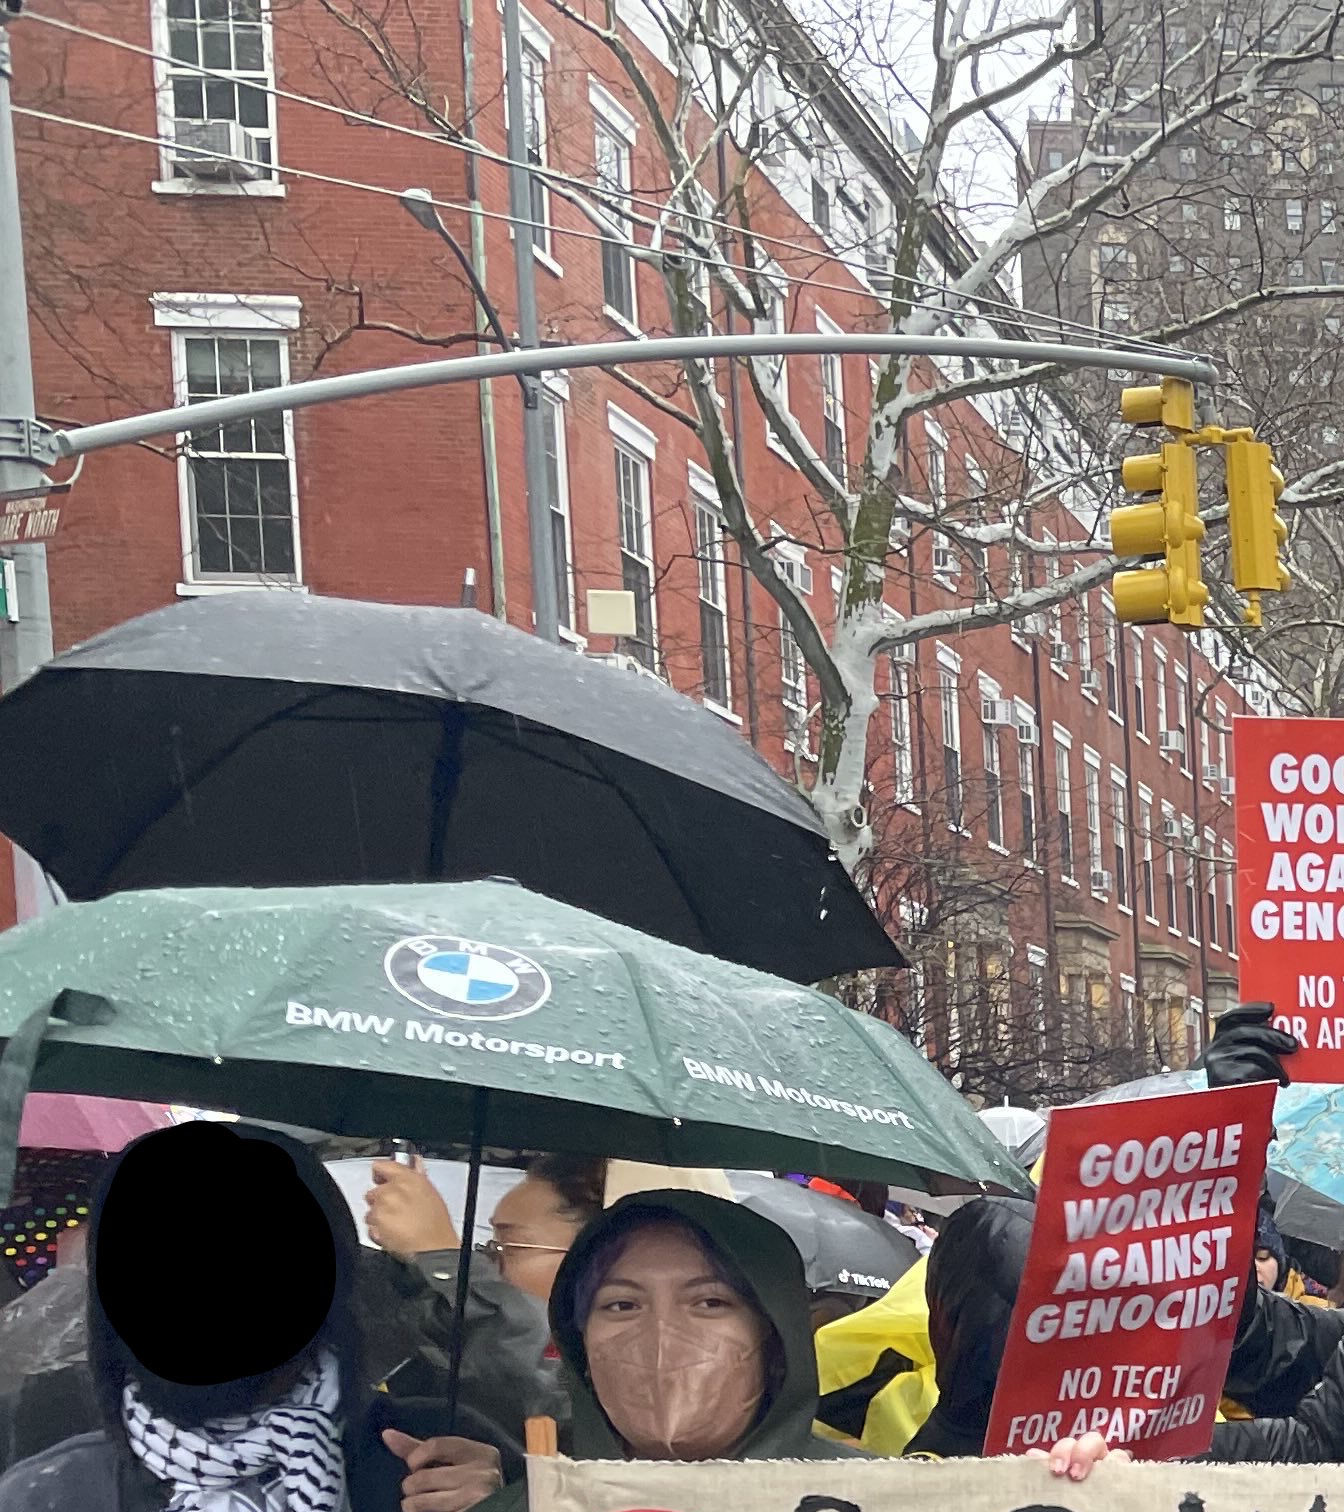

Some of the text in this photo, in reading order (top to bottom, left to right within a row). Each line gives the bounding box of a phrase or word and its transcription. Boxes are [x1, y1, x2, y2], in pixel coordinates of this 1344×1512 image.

[1299, 975, 1336, 1009] NO
[285, 1001, 626, 1070] BMW Motorsport
[1270, 1016, 1309, 1049] OR
[682, 1056, 915, 1130] BMW Motorsport
[1079, 1123, 1243, 1188] GOOGLE
[1063, 1176, 1238, 1242] WORKER
[1053, 1226, 1232, 1295] AGAINST
[1025, 1276, 1239, 1343] GENOCIDE
[1058, 1365, 1182, 1401] NO TECH
[1006, 1394, 1205, 1448] FOR APARTHEID
